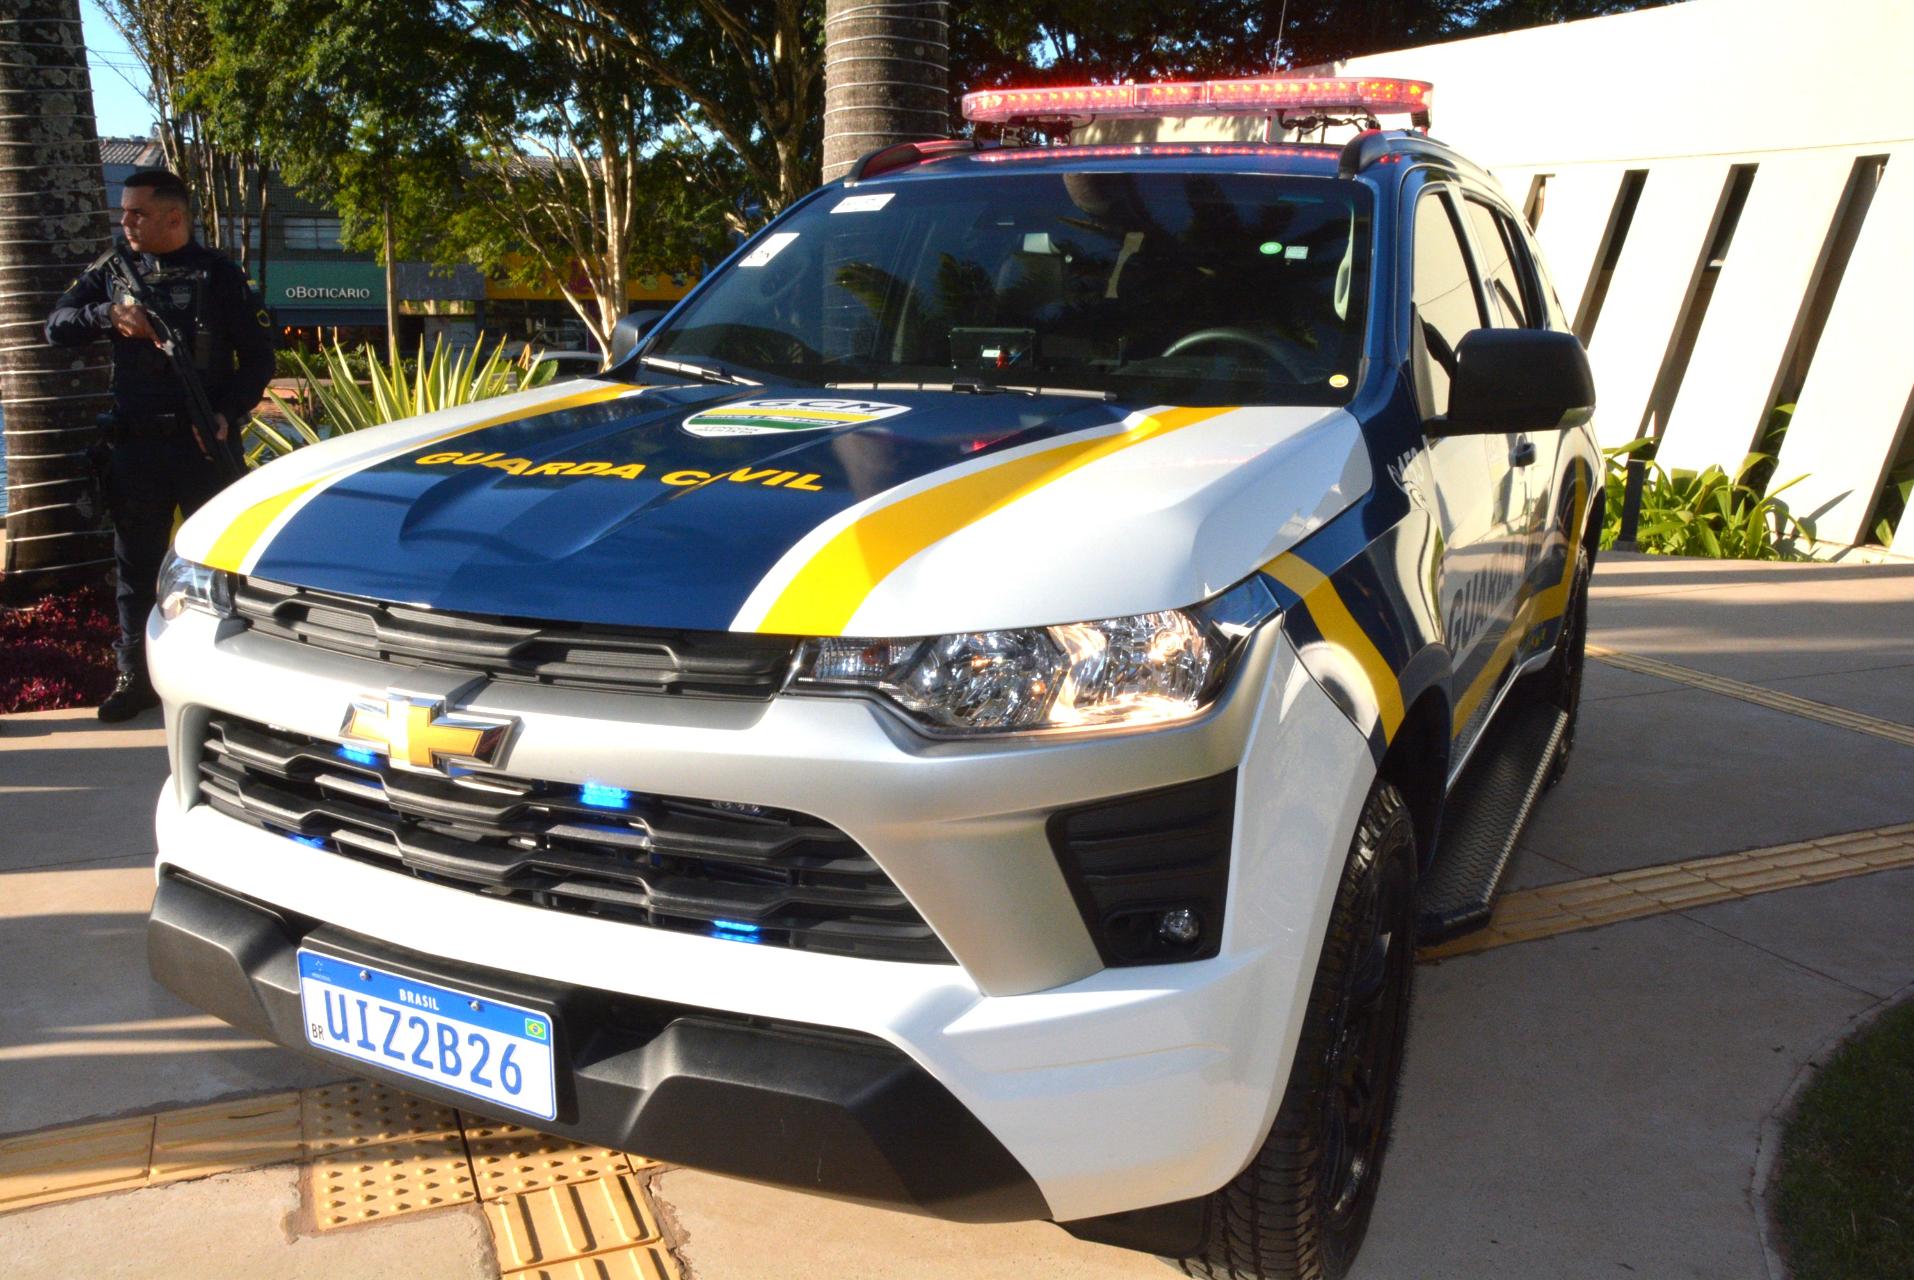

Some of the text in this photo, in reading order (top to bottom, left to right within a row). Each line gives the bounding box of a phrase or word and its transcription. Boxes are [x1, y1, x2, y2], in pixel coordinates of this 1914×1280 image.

[749, 400, 898, 413] GCM
[415, 452, 824, 492] GUARDA CIVIL
[399, 988, 440, 1011] BRASIL
[311, 1023, 325, 1041] BR
[324, 989, 523, 1096] UIZ2B26
